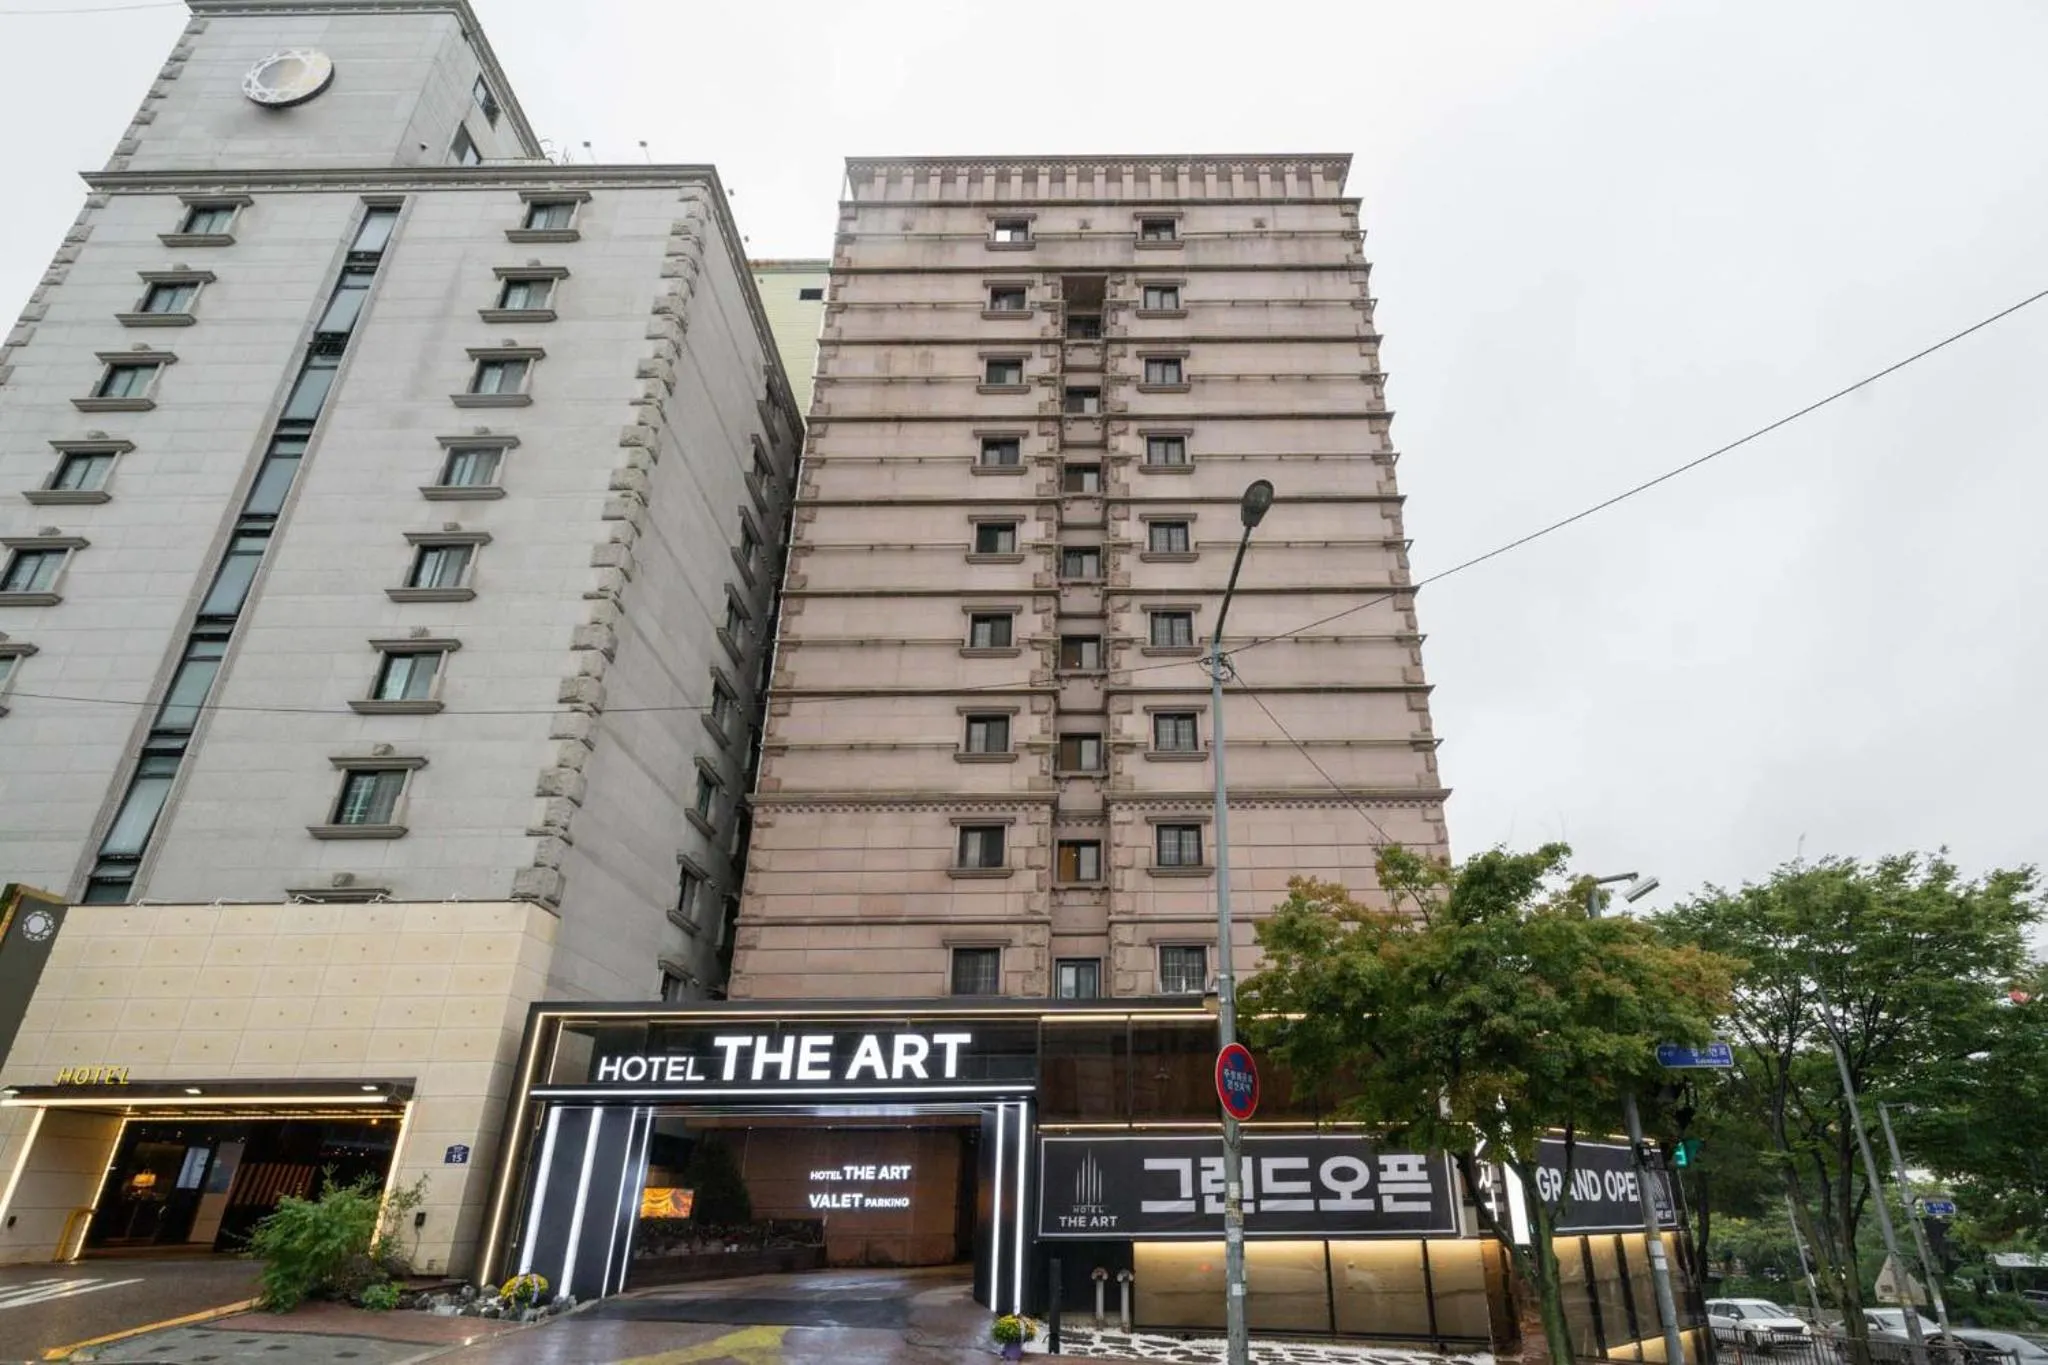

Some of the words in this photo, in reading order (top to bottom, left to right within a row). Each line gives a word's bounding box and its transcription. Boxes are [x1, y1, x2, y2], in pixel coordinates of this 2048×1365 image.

[597, 1056, 705, 1082] HOTEL
[713, 1034, 834, 1081] THE
[844, 1033, 972, 1080] ART
[57, 1066, 130, 1085] HOTEL
[810, 1170, 843, 1180] HOTEL
[843, 1165, 876, 1180] THE
[878, 1165, 912, 1180] ART
[808, 1193, 863, 1208] VALET
[864, 1197, 910, 1208] PARKING
[1059, 1215, 1087, 1228] THE
[1090, 1215, 1118, 1228] ART
